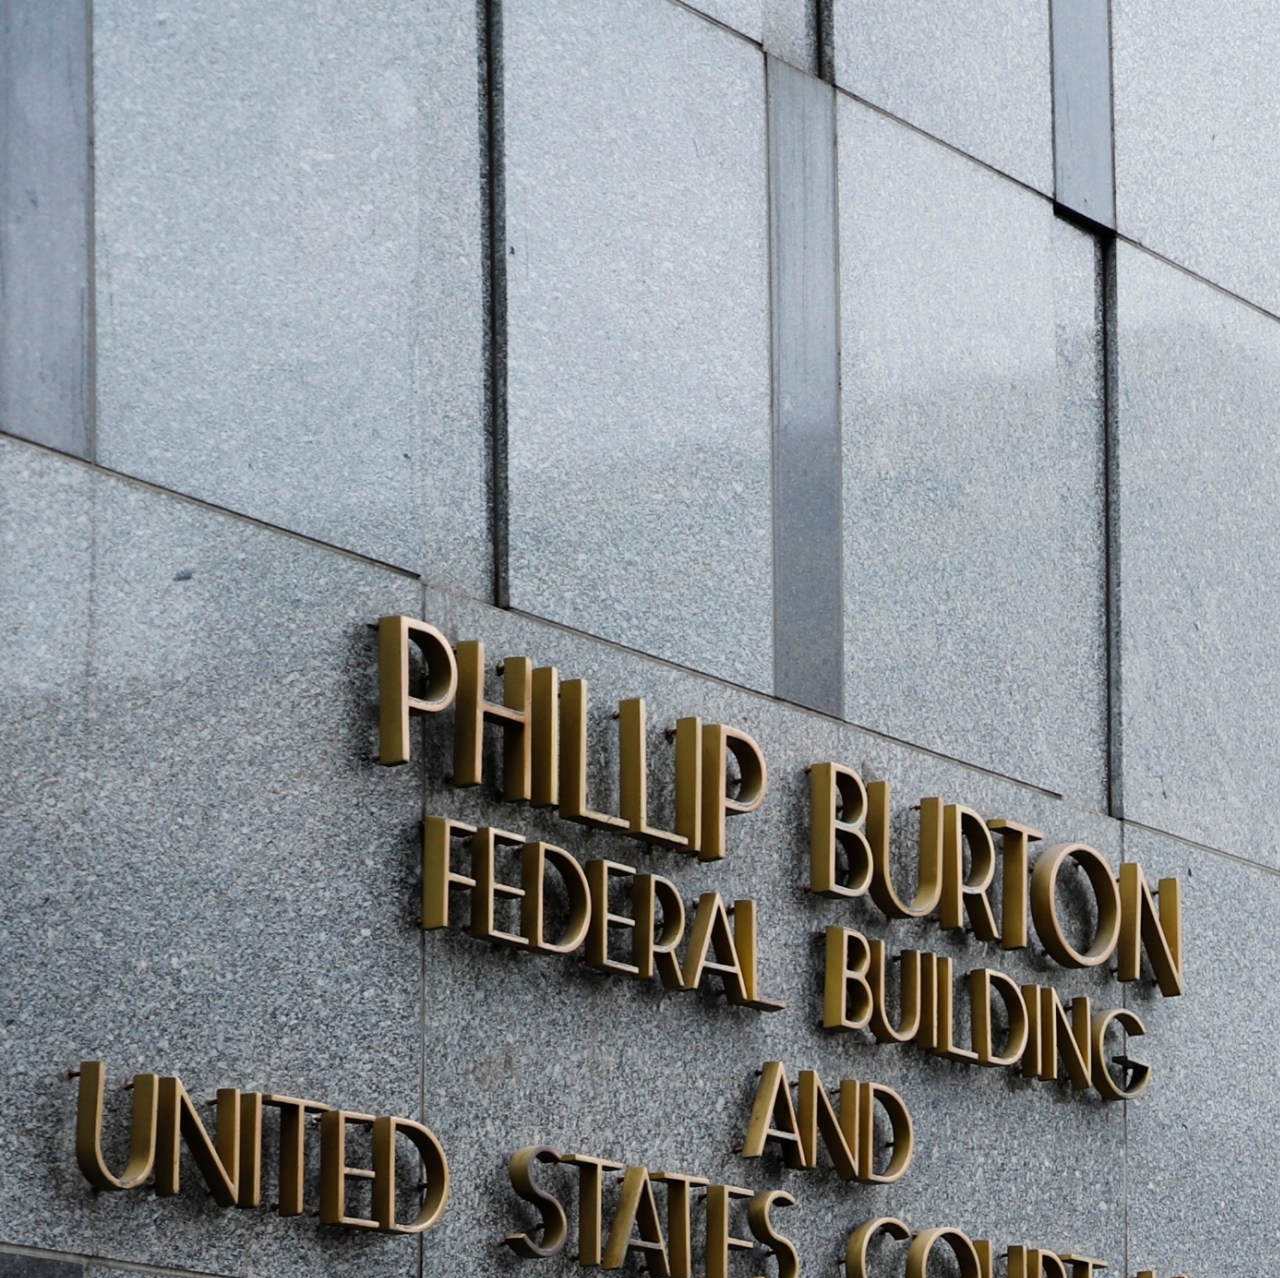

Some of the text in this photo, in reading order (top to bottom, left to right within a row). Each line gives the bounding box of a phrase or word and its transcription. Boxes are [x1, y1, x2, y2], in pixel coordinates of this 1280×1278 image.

[379, 614, 1183, 998] PHILLIP BURTON
[423, 814, 1152, 1101] FEDERAL BUILDING
[76, 1060, 451, 1235] UNITED
[742, 1060, 914, 1185] AND
